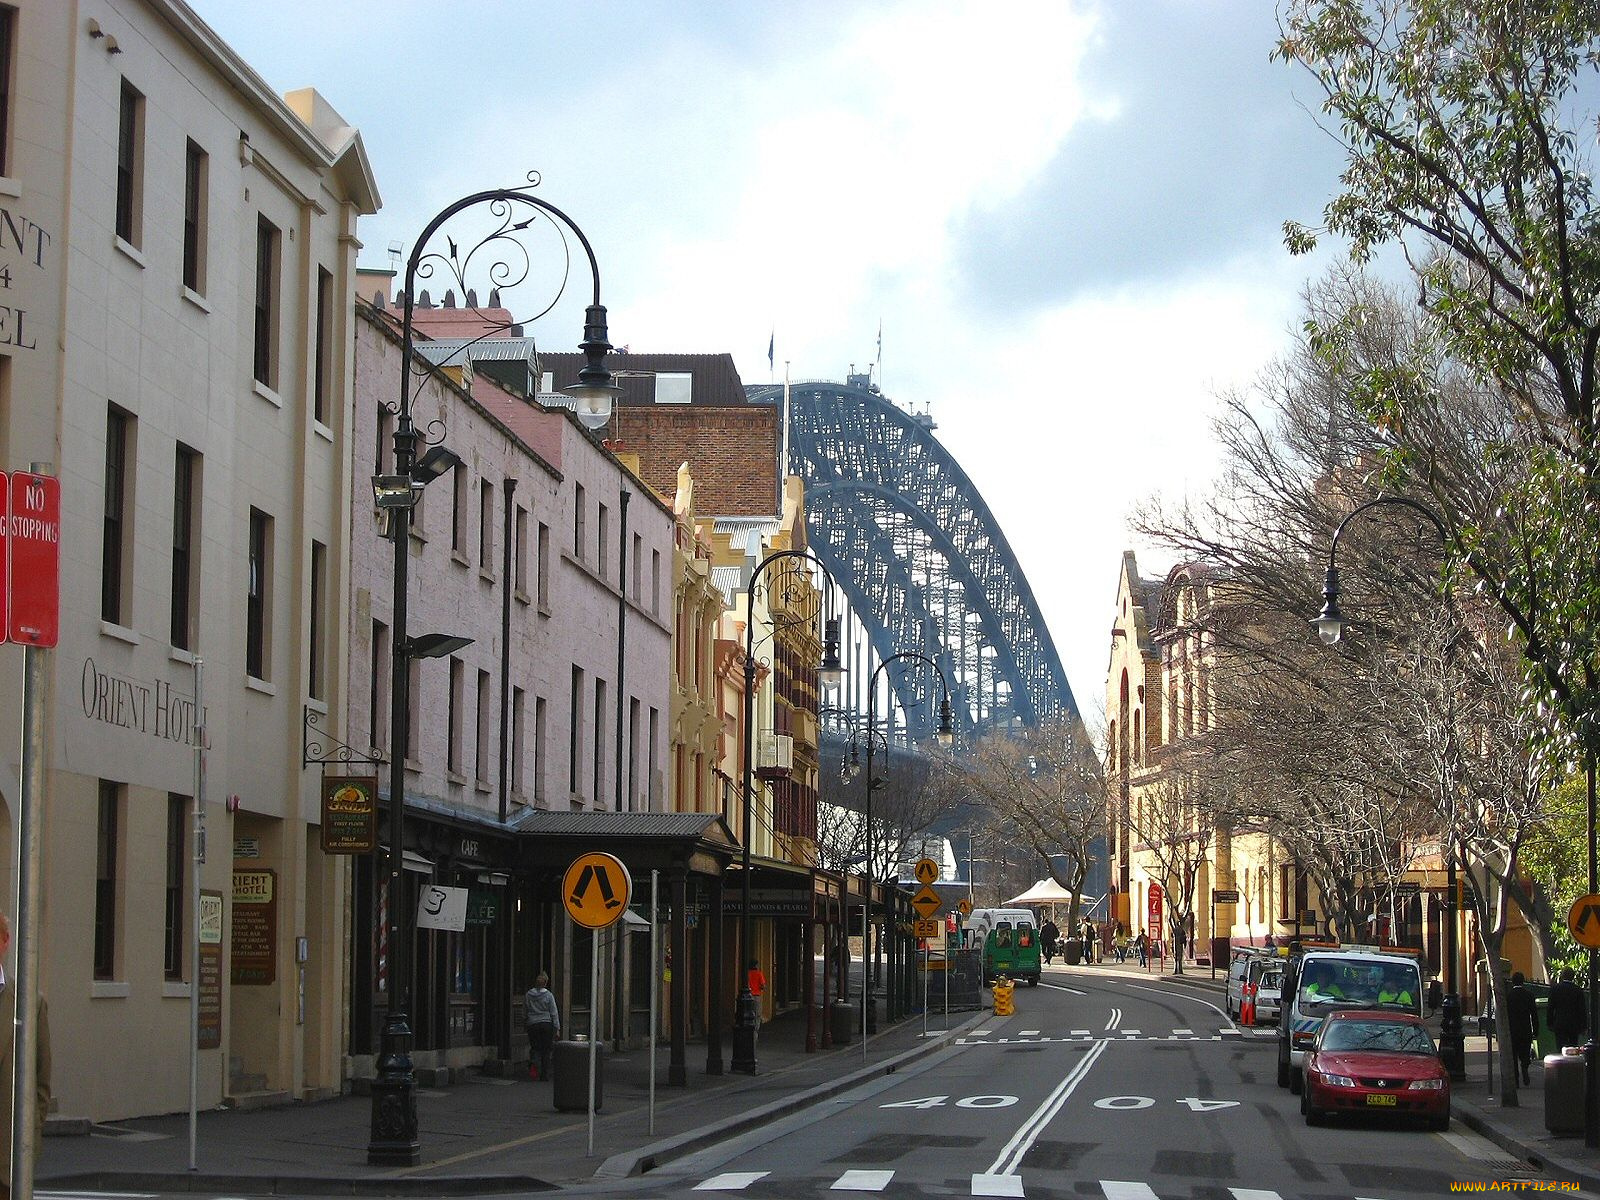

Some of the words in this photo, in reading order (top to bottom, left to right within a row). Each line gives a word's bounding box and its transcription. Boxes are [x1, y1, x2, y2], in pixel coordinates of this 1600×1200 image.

[25, 485, 45, 512] NO
[12, 515, 58, 544] STOPPING
[82, 657, 150, 733] ORIENT
[153, 679, 212, 751] HOTL
[461, 839, 479, 857] CAFE
[232, 875, 269, 887] RIENT
[235, 885, 268, 895] HOTEL
[919, 922, 934, 932] 25
[879, 1095, 1020, 1109] 40
